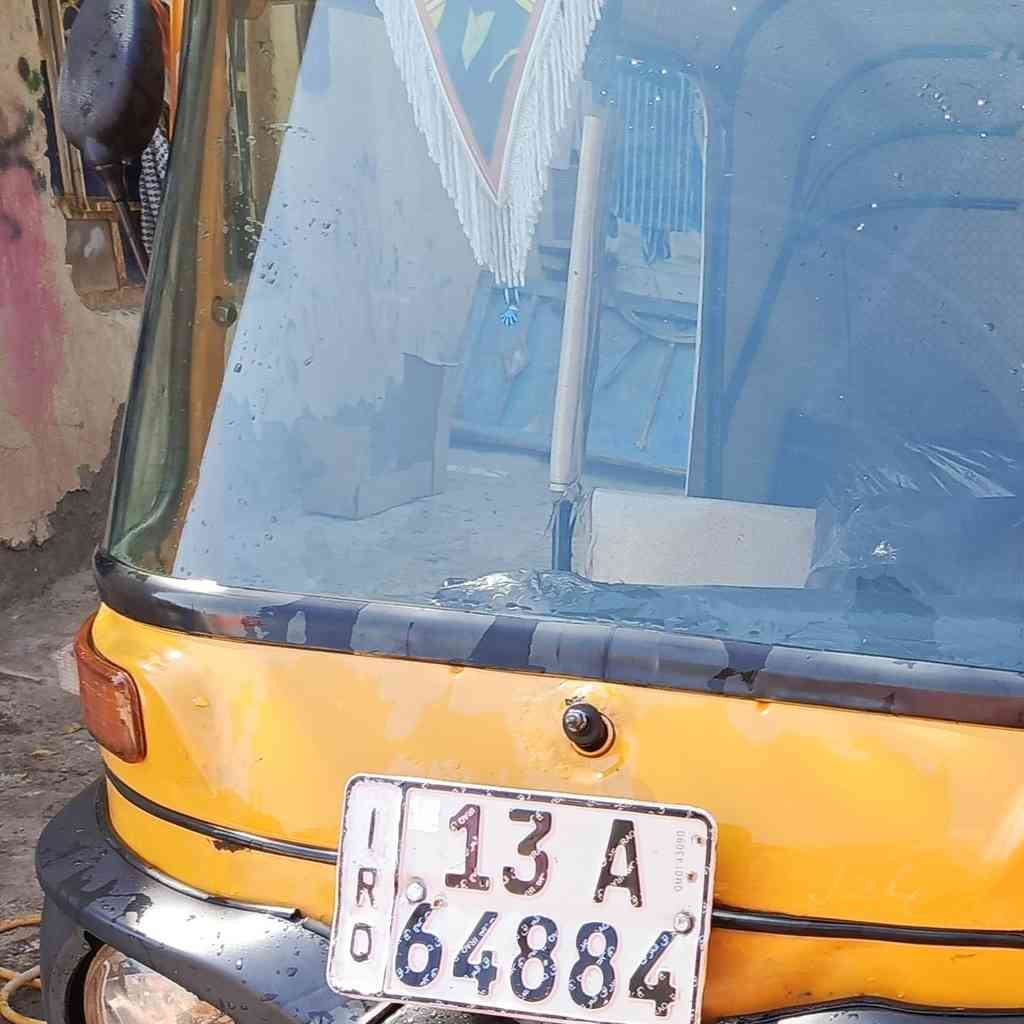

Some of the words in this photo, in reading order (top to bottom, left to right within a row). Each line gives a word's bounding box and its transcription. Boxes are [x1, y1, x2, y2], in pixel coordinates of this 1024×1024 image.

[444, 803, 553, 897] 13
[592, 818, 643, 908] A
[394, 901, 677, 1017] 64884
